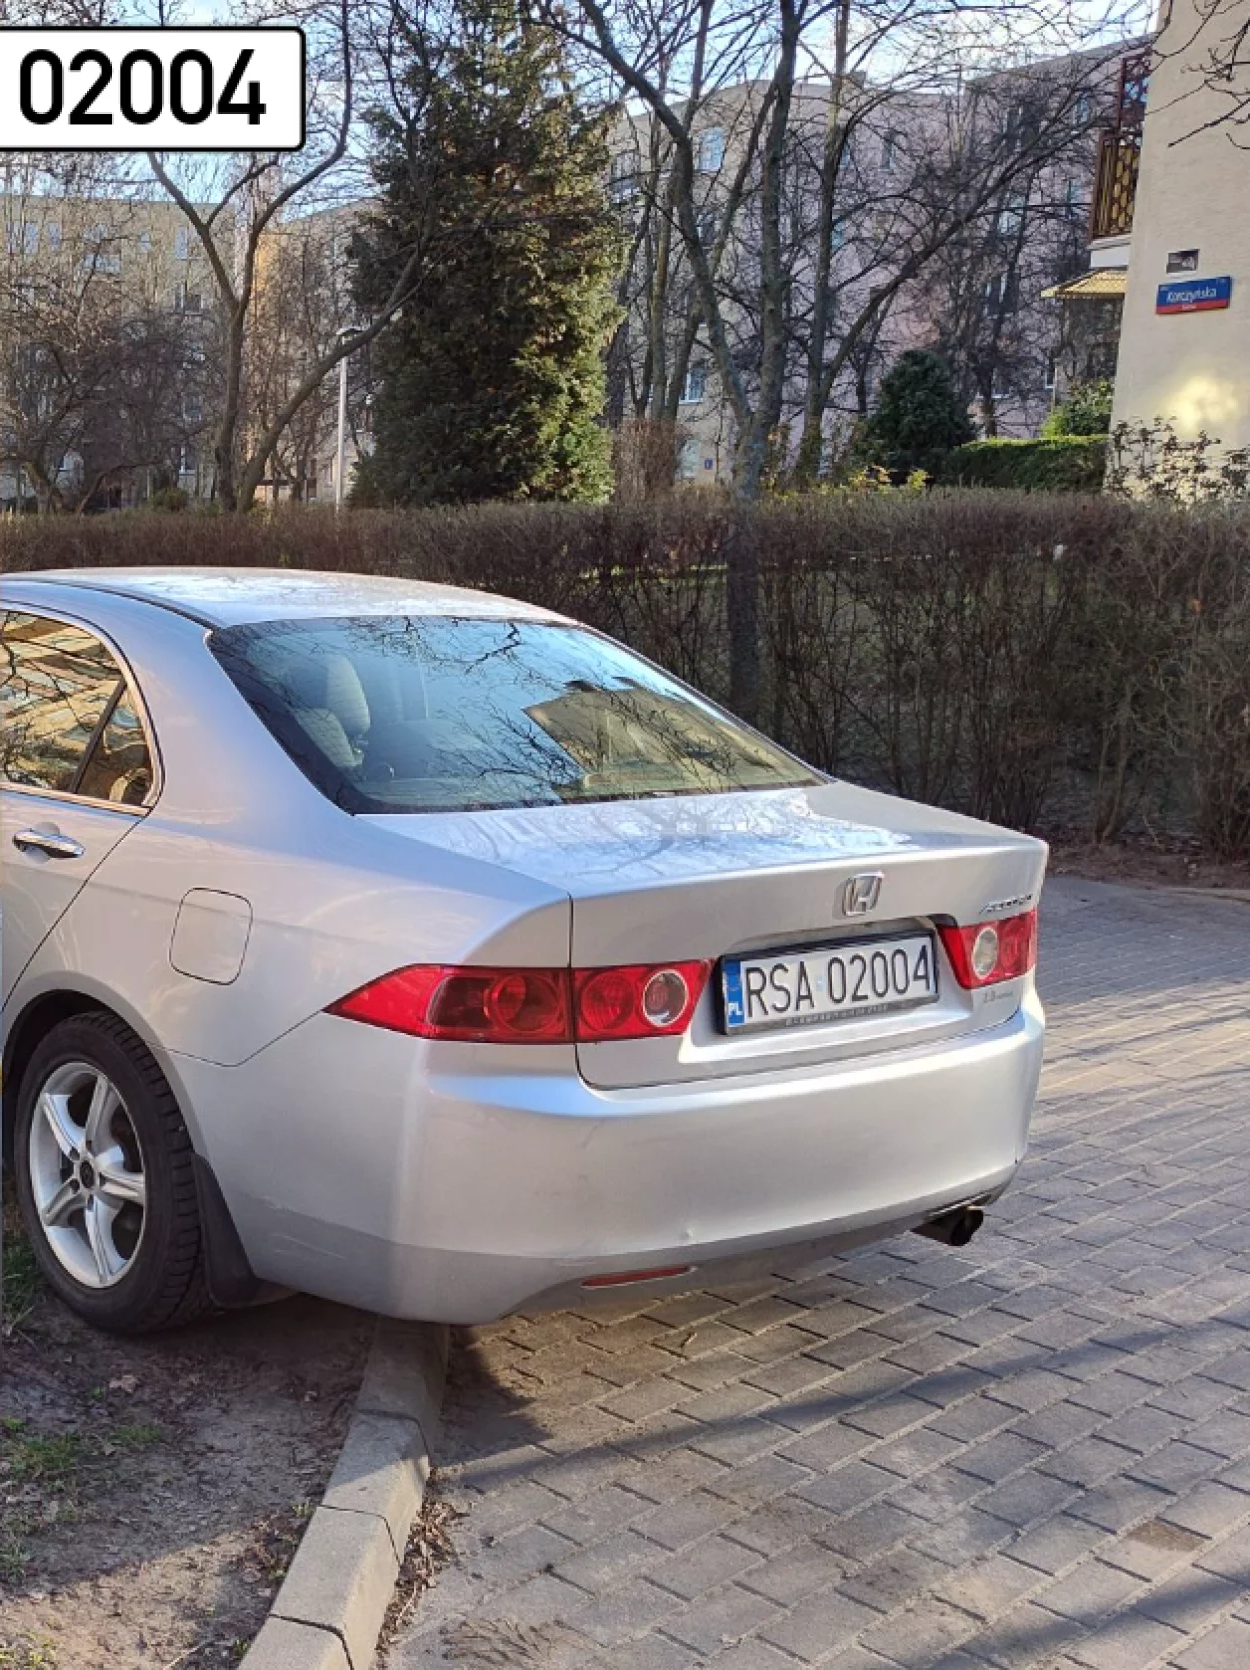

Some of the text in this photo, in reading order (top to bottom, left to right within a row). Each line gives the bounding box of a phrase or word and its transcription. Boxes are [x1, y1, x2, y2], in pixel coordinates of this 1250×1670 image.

[745, 944, 931, 1017] RSA 02004
[728, 1002, 744, 1017] PL
